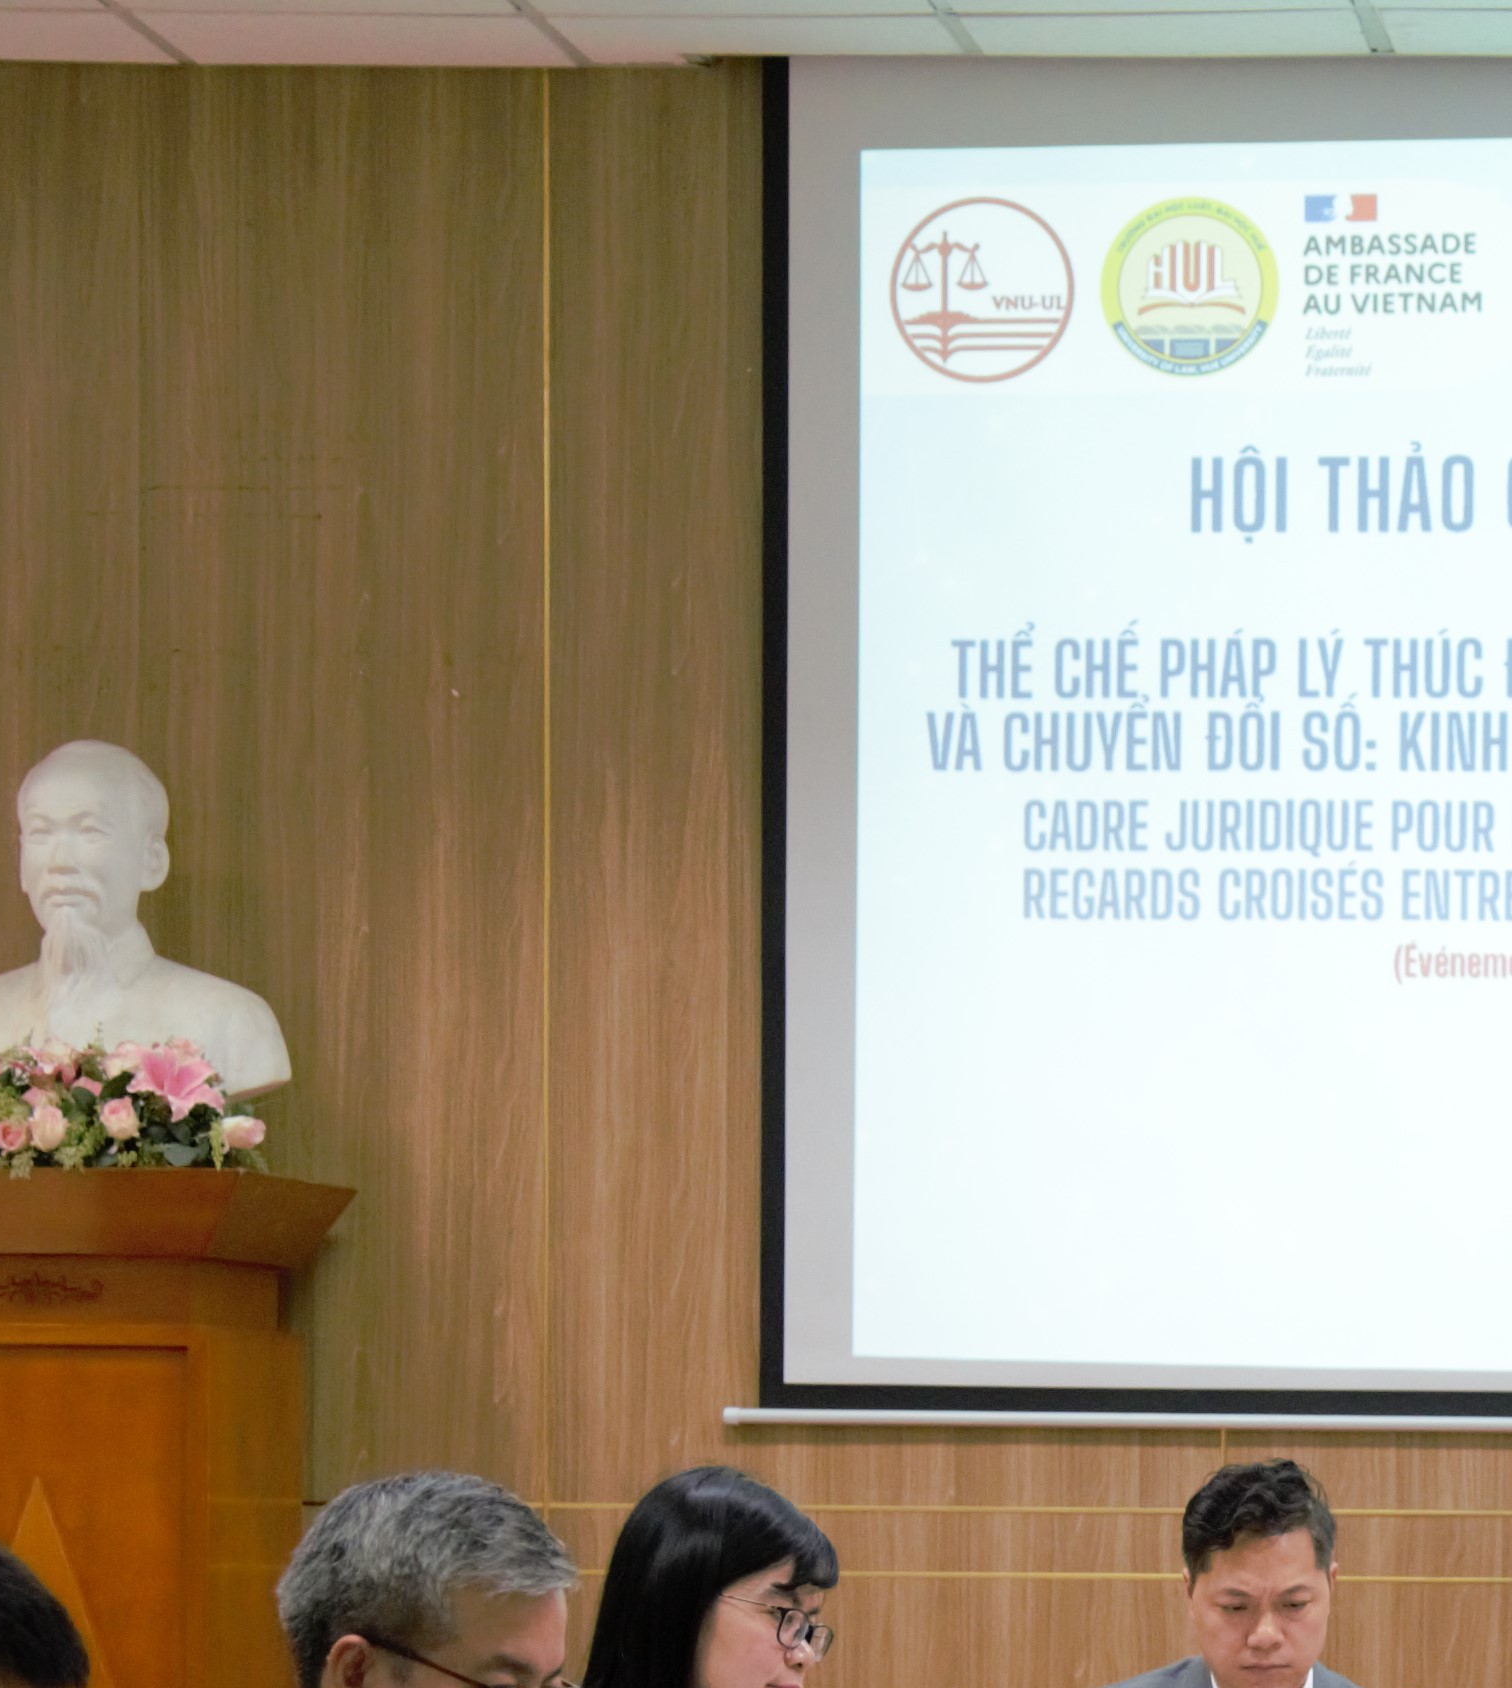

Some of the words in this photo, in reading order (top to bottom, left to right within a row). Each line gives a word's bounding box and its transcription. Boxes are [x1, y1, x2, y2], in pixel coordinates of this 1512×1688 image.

[1303, 233, 1476, 256] AMBASSADE
[1304, 263, 1339, 286] DE
[1350, 262, 1462, 285] FRANCE
[991, 294, 1065, 312] VNU-UL
[1303, 293, 1341, 315] AU
[1351, 292, 1482, 314] VIETNAM
[1189, 444, 1288, 544] HỘI
[1318, 440, 1476, 535] THẢO
[951, 620, 1036, 700] THỂ
[1053, 619, 1140, 700] CHẾ
[1159, 628, 1277, 700] PHÁP
[1297, 628, 1345, 700] LÝ
[1364, 628, 1484, 700] THÚC
[926, 703, 983, 772] VÀ
[1003, 693, 1182, 773] CHUYỂN
[1205, 693, 1281, 773] ĐỔI
[1302, 692, 1379, 773] SỐ:
[1398, 711, 1508, 773] KINH
[1023, 800, 1149, 853] CADRE
[1165, 800, 1374, 857] JURIDIQUE
[1390, 800, 1495, 853] POUR
[1022, 867, 1201, 920] REGARDS
[1218, 861, 1385, 921] CROISÉS
